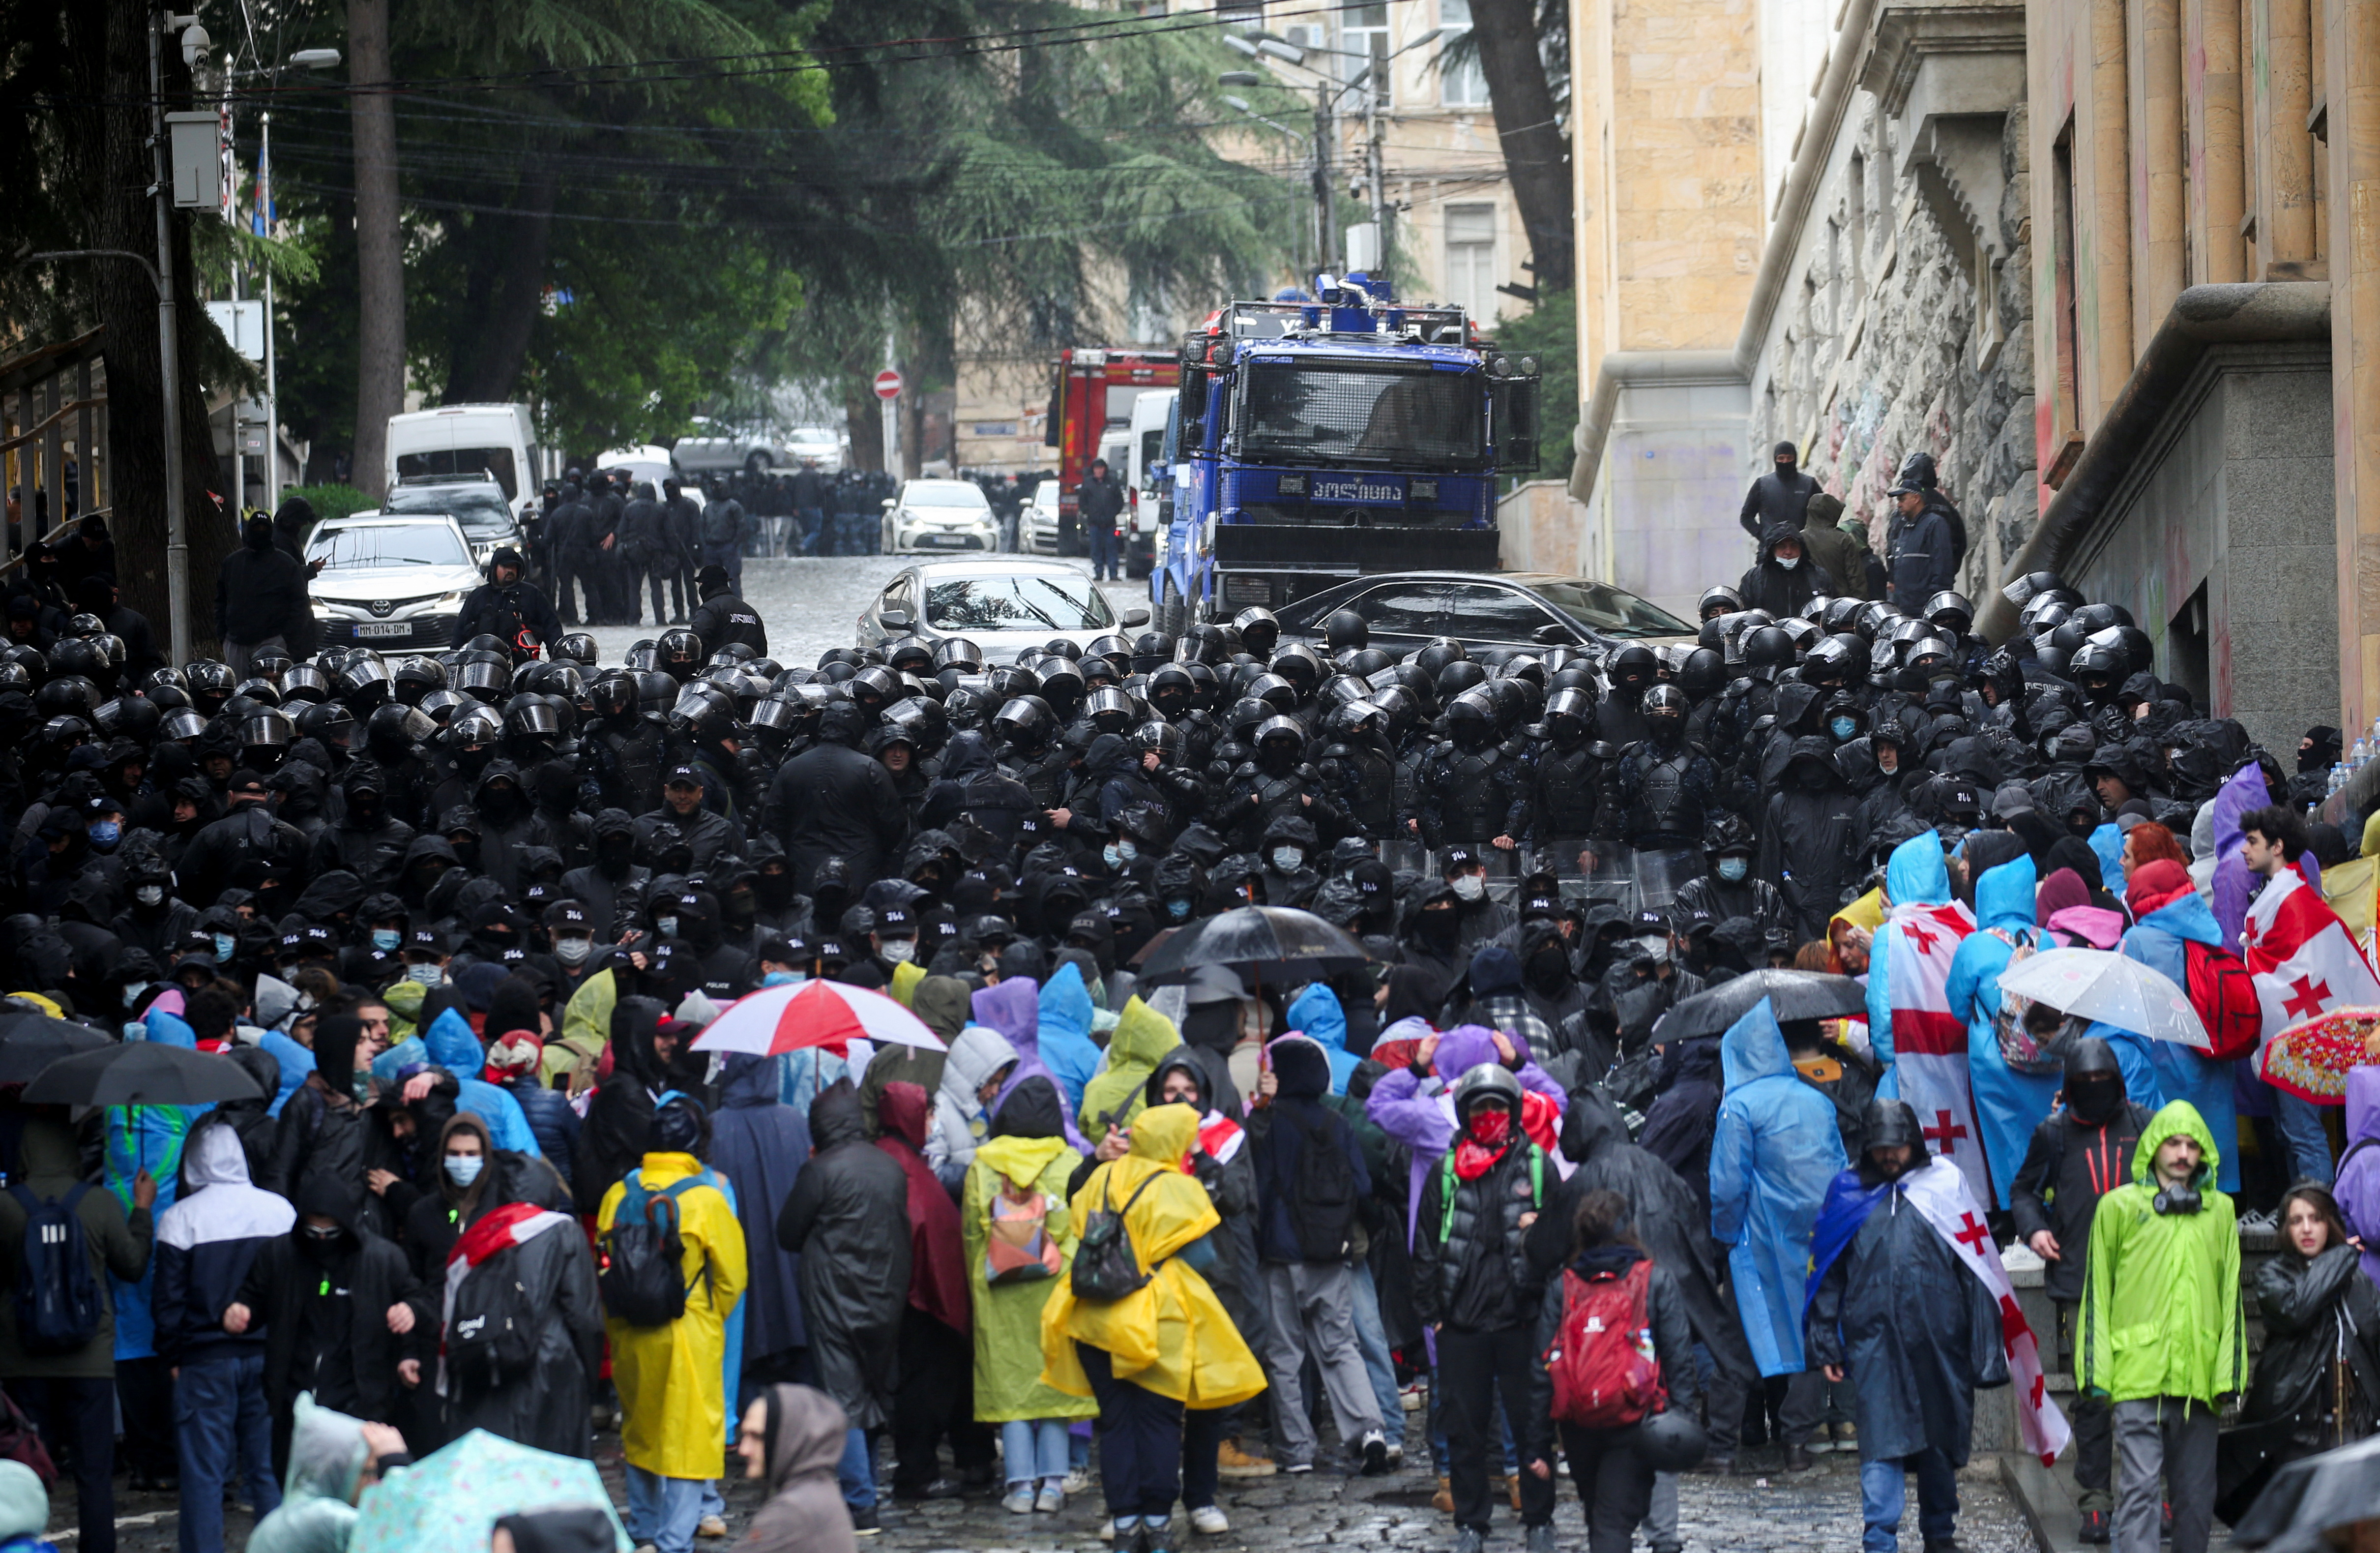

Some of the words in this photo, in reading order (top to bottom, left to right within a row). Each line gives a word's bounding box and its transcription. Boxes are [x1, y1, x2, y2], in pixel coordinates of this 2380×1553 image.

[1314, 482, 1402, 501] პოლიცია
[359, 625, 405, 635] MM-014-DM
[1957, 792, 1971, 802] შსს
[1023, 821, 1036, 831] შსს
[1451, 850, 1467, 861] შსს
[1643, 912, 1659, 922] შსს
